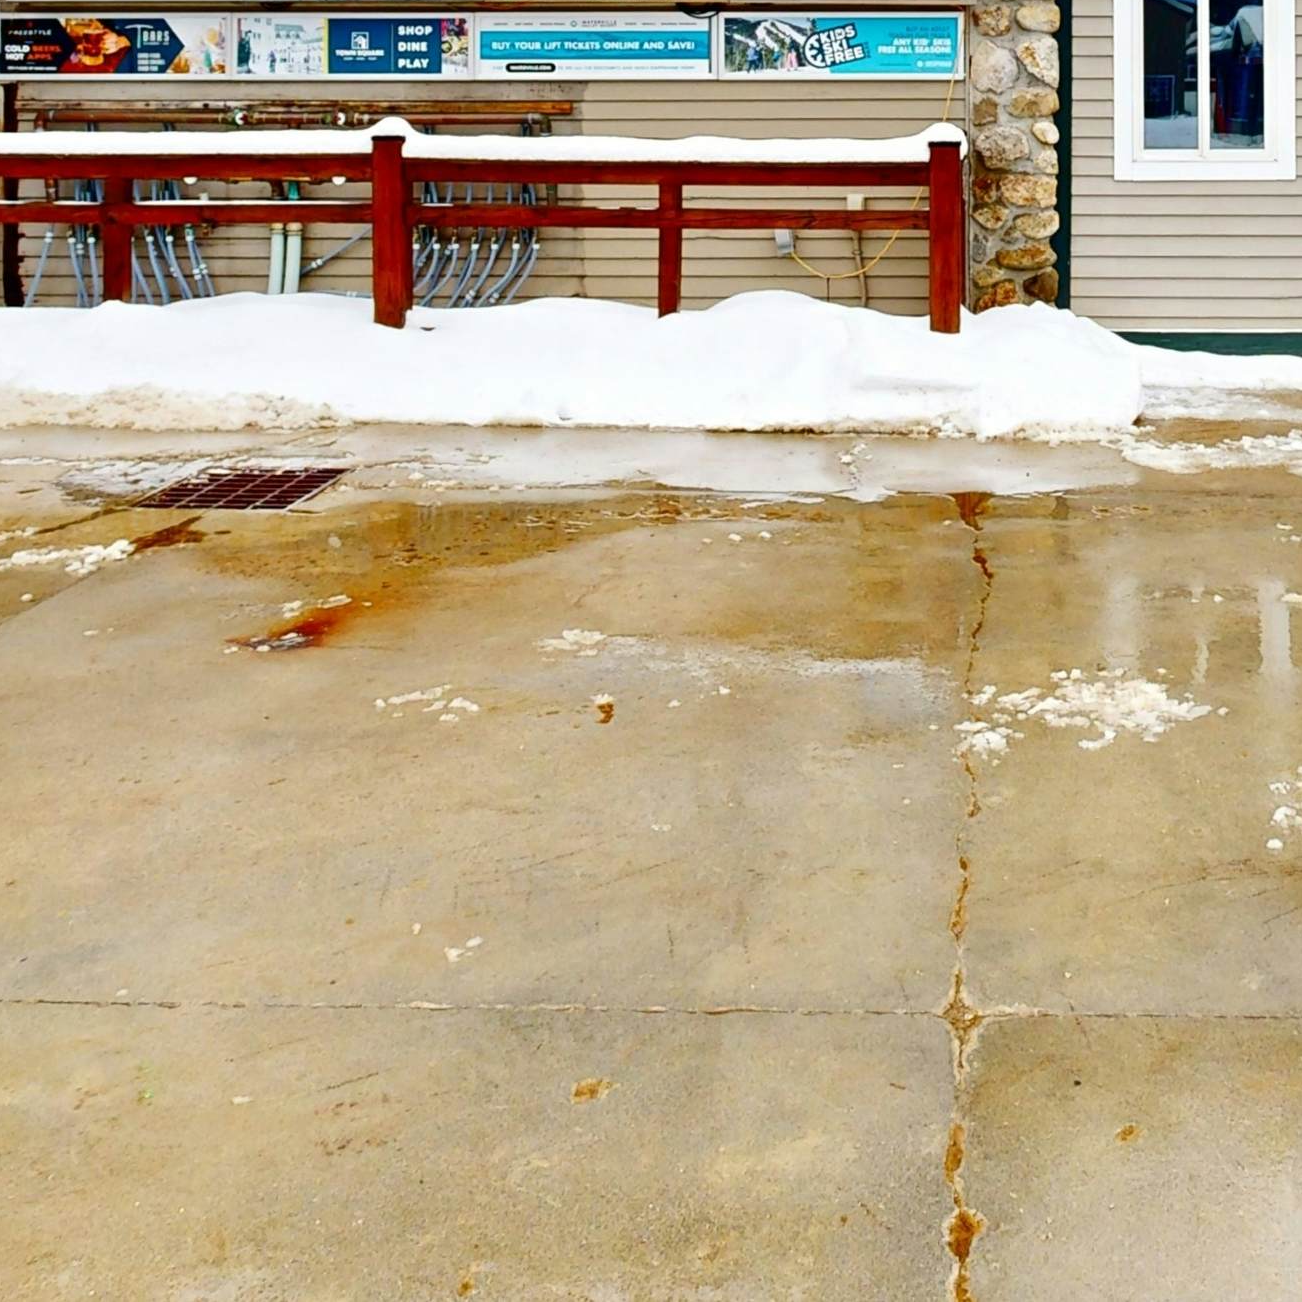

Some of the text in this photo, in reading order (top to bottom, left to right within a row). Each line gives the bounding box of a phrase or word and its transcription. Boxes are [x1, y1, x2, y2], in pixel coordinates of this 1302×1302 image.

[398, 25, 433, 36] SHOP
[820, 25, 855, 44] KIDS
[4, 44, 31, 53] COLD
[397, 41, 428, 52] DINE
[491, 41, 695, 50] BUY YOUR LIFT TICKETS ONLINE AND SAVE!
[822, 39, 848, 54] SKI
[5, 53, 25, 61] HOT
[335, 49, 385, 57] TOWN SQUARE
[824, 46, 865, 66] FREE
[398, 58, 429, 69] PLAY
